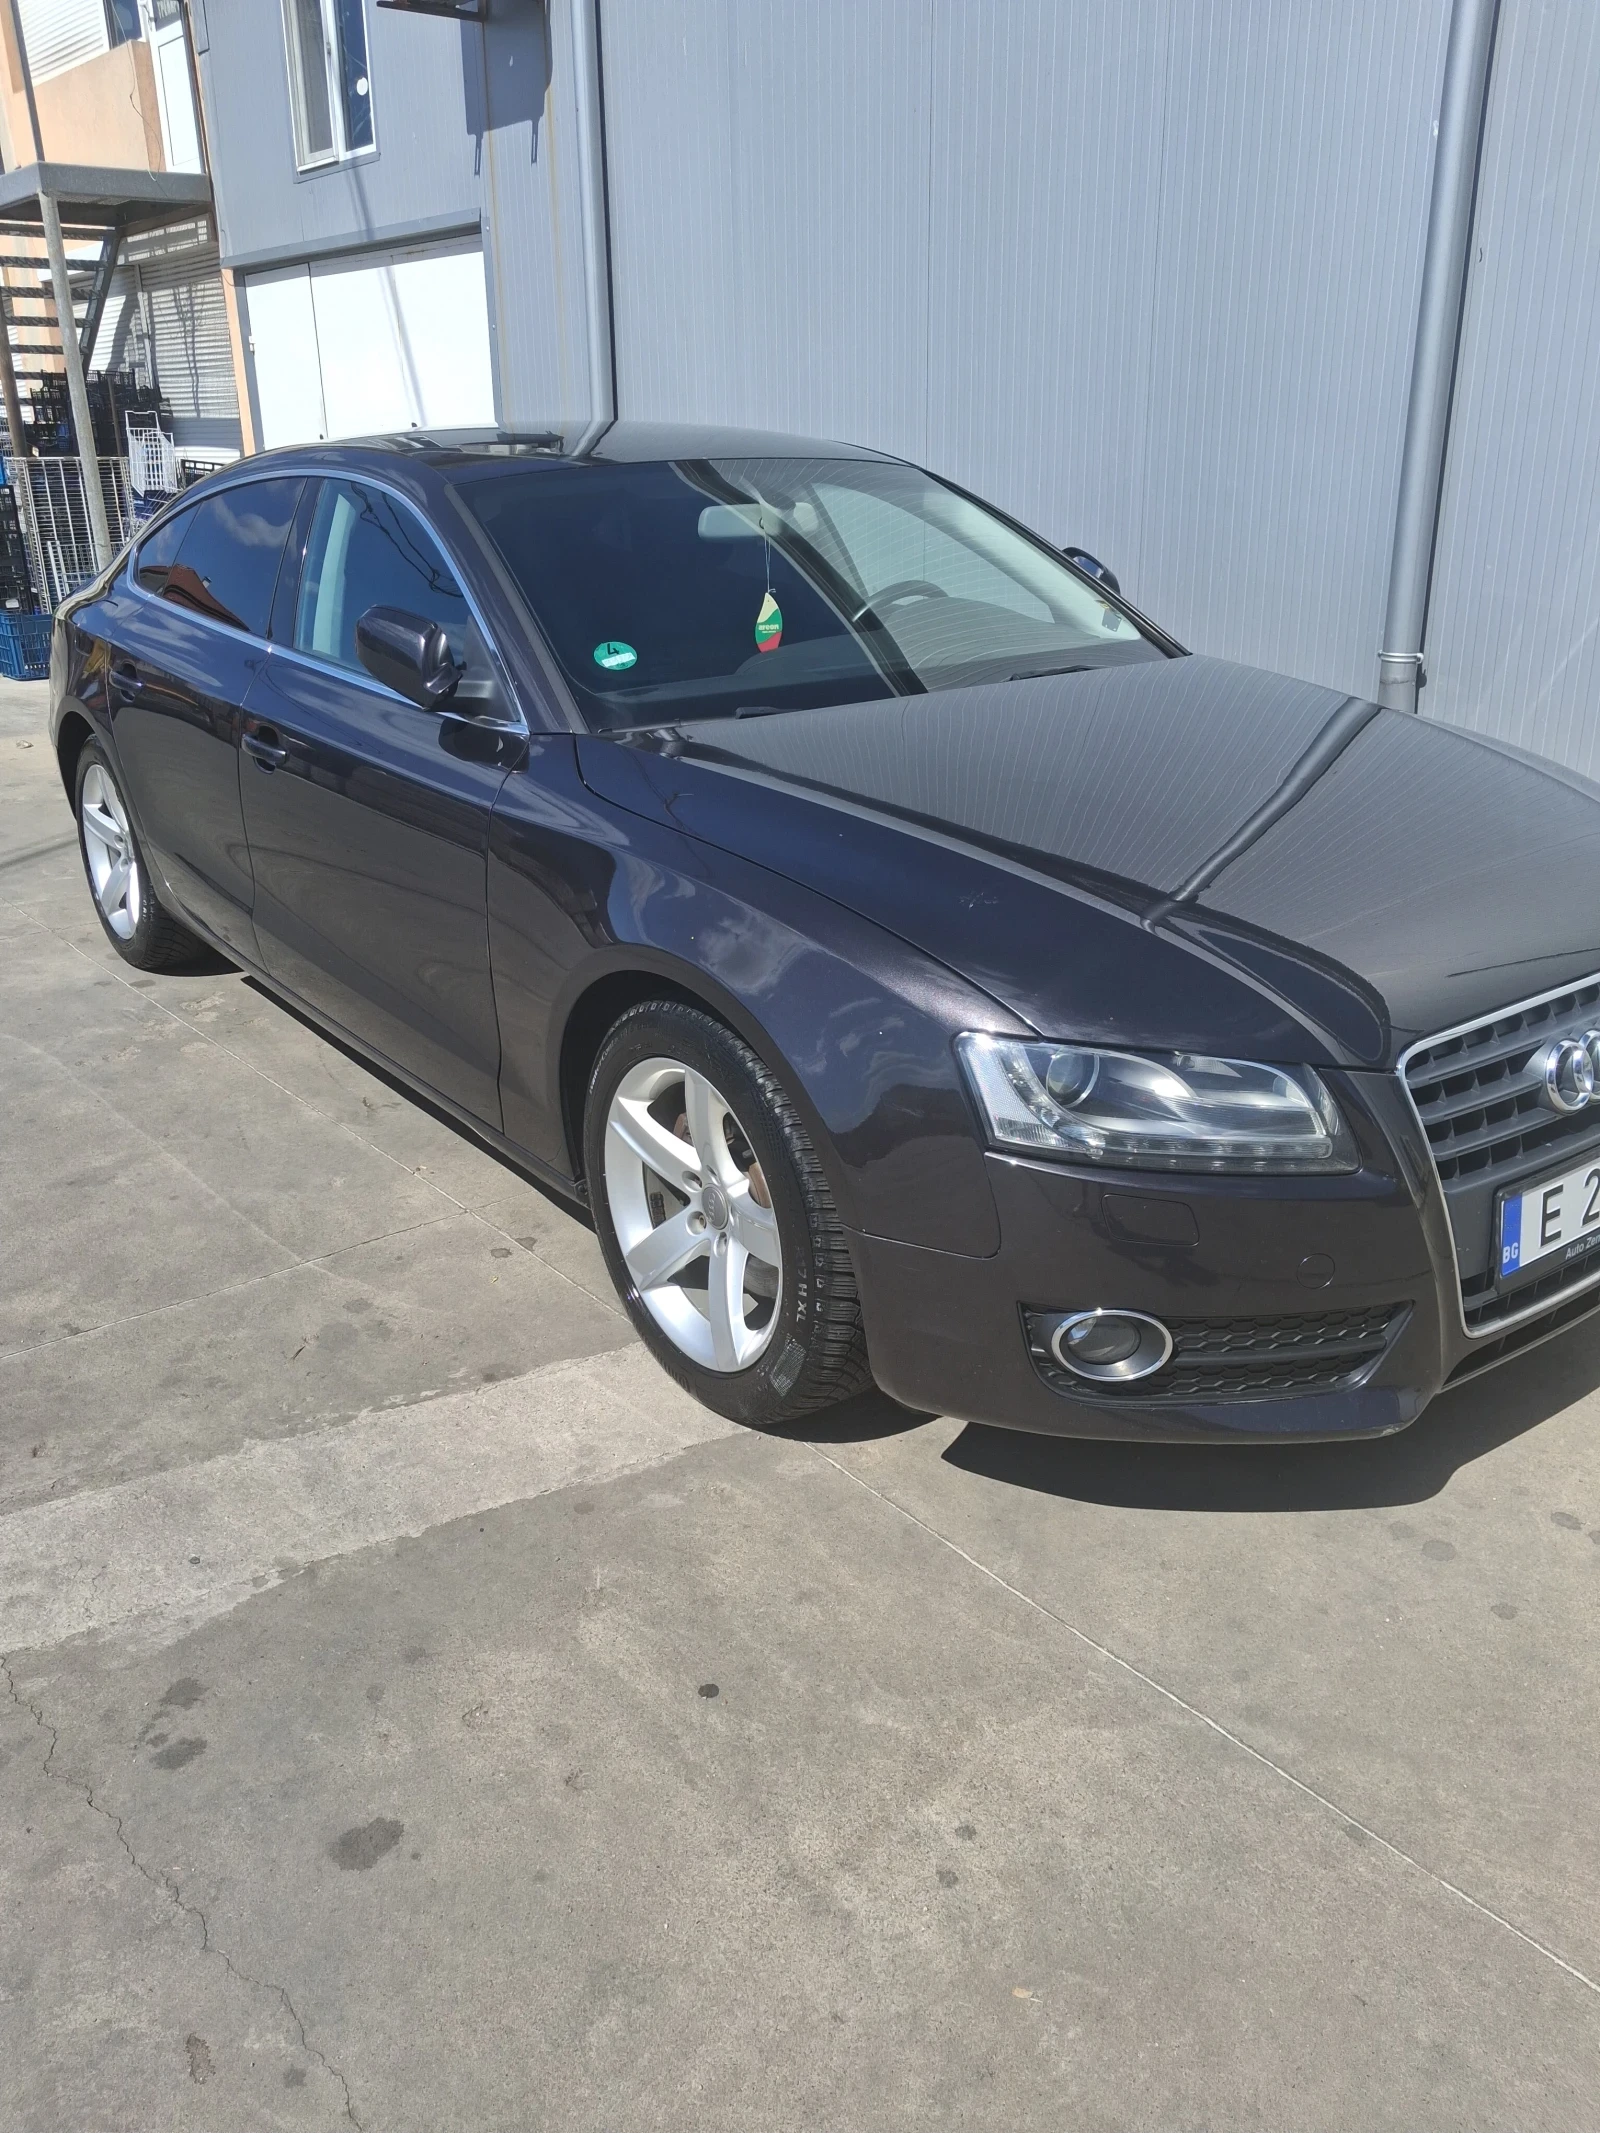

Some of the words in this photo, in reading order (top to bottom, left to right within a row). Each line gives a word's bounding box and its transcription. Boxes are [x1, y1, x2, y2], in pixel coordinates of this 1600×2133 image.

[607, 642, 620, 655] 4
[1539, 1183, 1563, 1249] E
[1581, 1168, 1600, 1228] 2
[1502, 1242, 1519, 1264] BG
[1565, 1243, 1585, 1260] Auto
